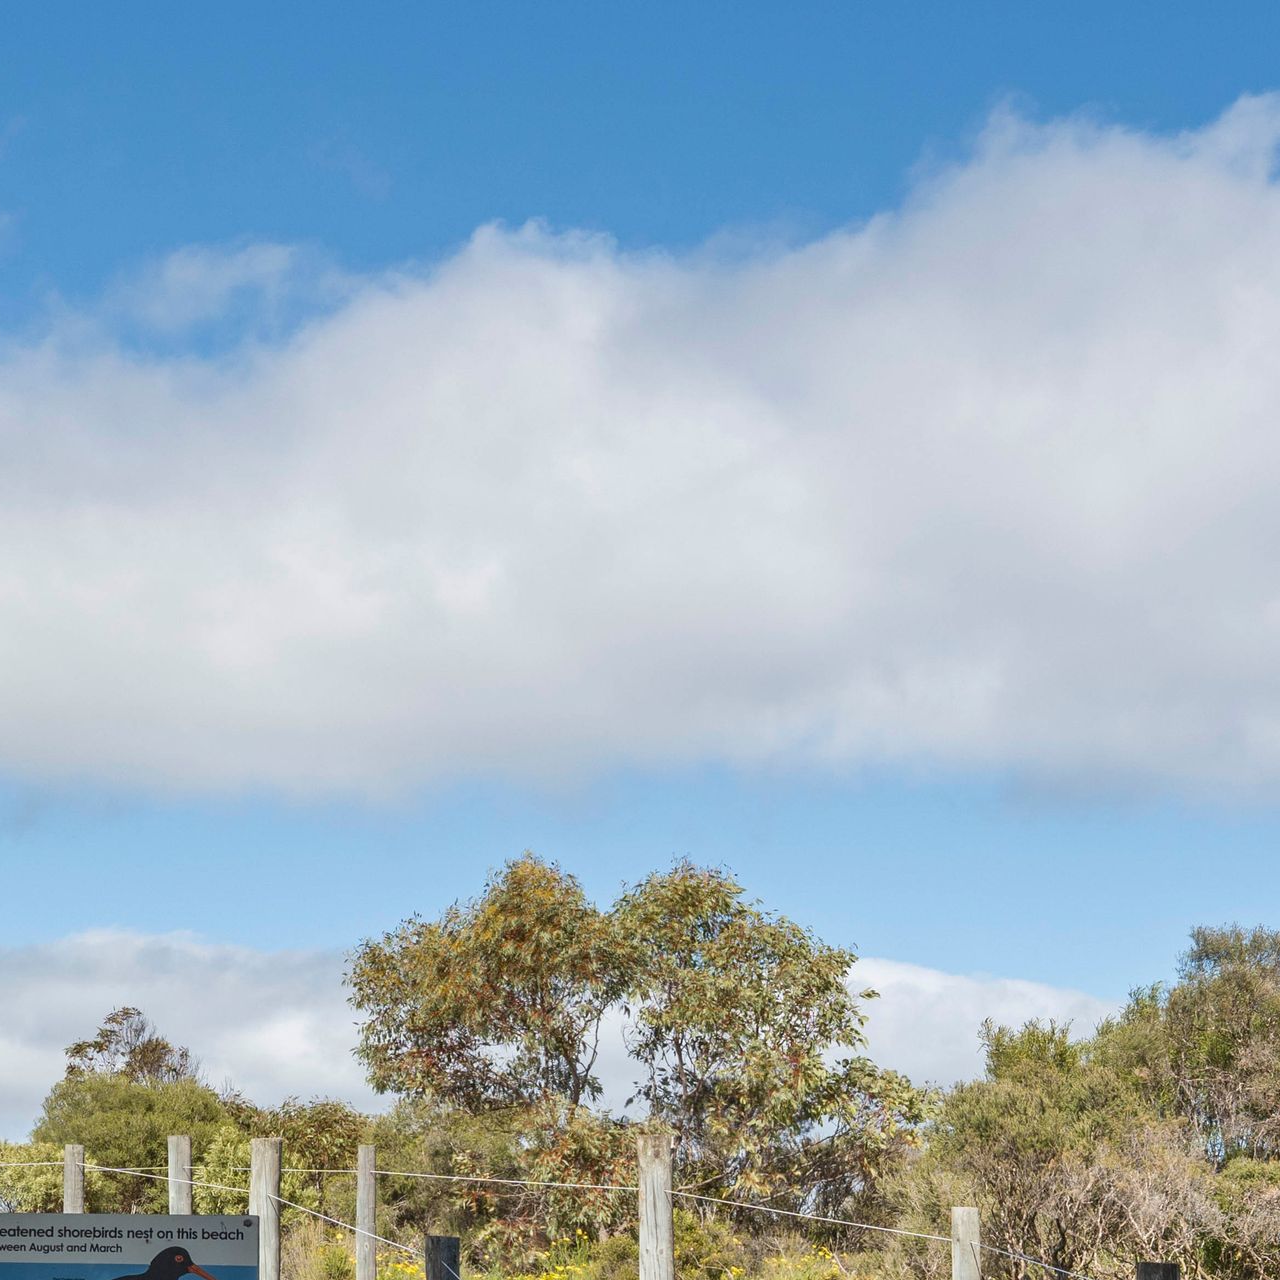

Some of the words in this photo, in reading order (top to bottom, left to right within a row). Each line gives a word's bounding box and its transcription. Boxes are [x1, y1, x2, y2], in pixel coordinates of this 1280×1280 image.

[57, 1226, 123, 1239] shorebirds
[127, 1228, 153, 1239] nest
[157, 1230, 173, 1239] on
[177, 1228, 198, 1239] this
[202, 1229, 244, 1240] beach
[29, 1243, 64, 1254] August
[66, 1243, 87, 1252] and
[90, 1243, 123, 1253] March
